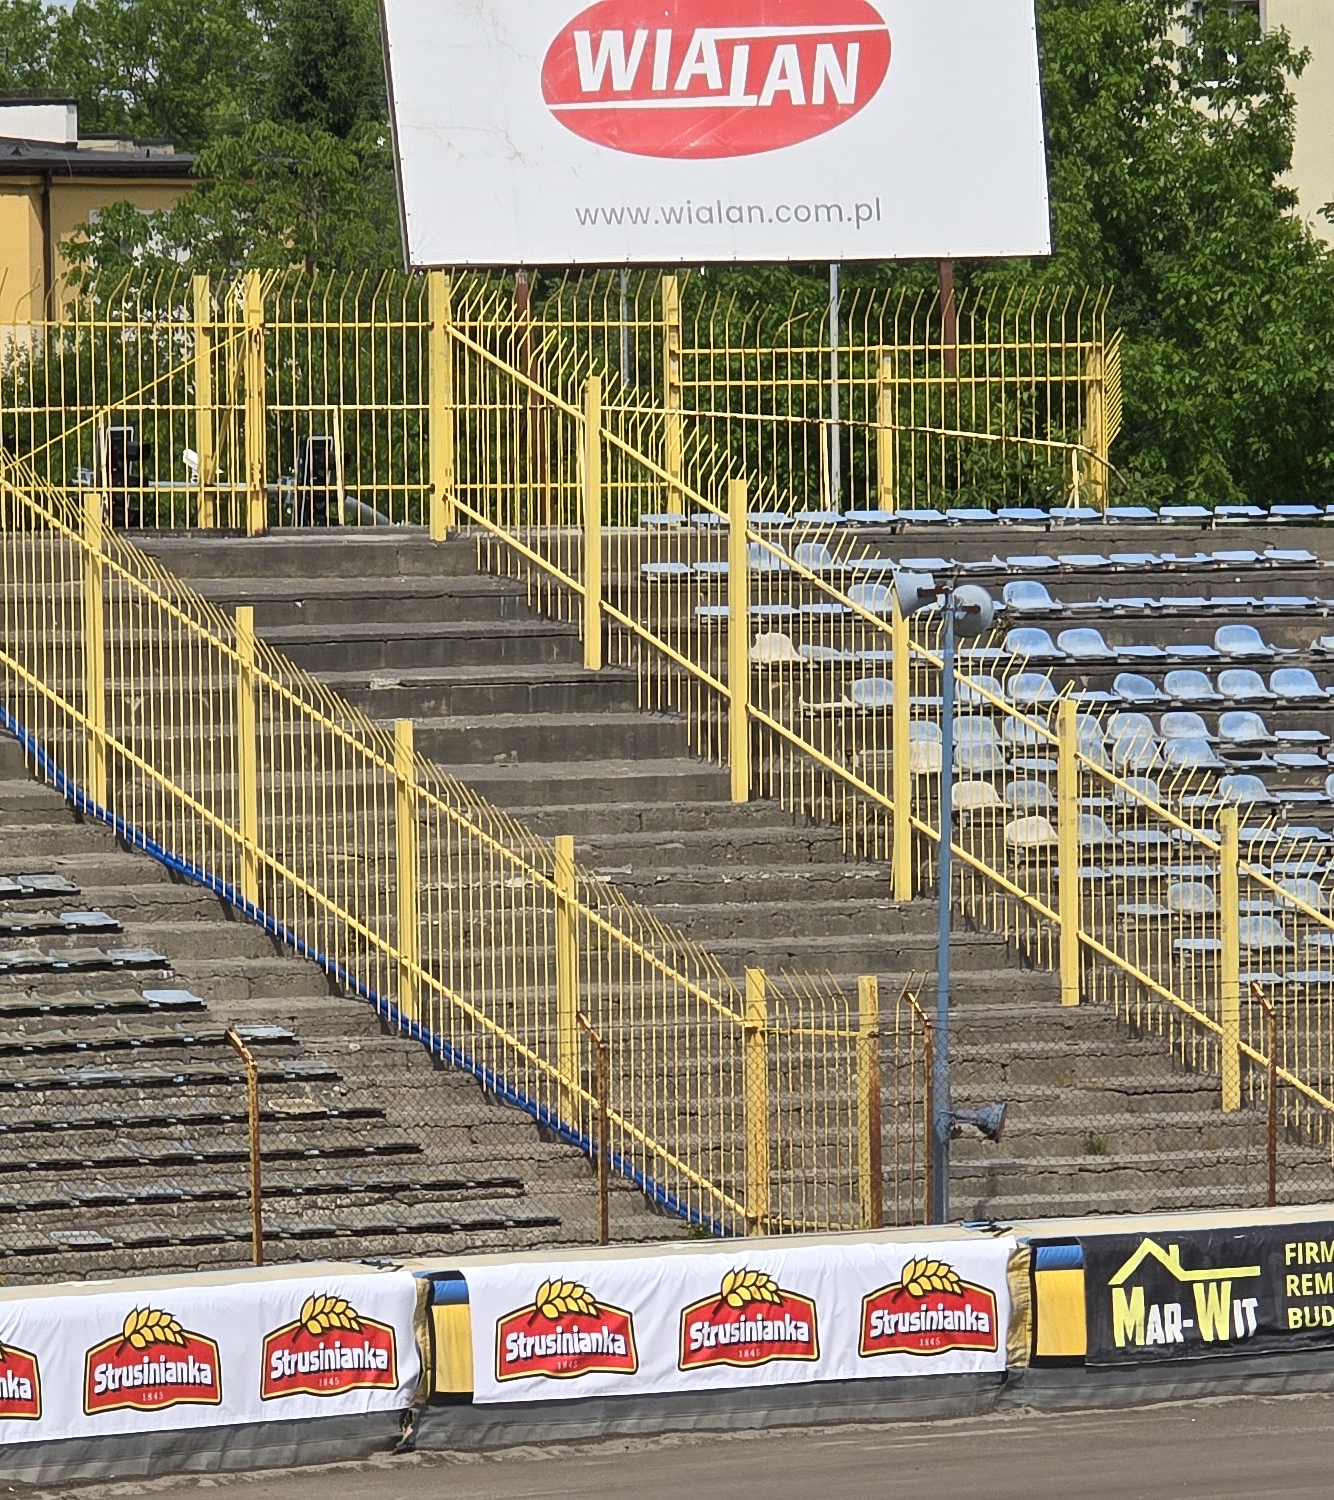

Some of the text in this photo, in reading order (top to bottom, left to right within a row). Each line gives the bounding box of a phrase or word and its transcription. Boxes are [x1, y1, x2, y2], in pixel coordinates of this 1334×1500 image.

[574, 27, 859, 107] WIALAN
[575, 197, 882, 229] www.wialan.com.pl
[690, 1313, 809, 1350] Strusinianka
[870, 1303, 990, 1338] Strusinianka
[271, 1341, 388, 1379] Strusinianka
[506, 1325, 626, 1361] Strusinianka
[94, 1355, 212, 1394] Strusinianka
